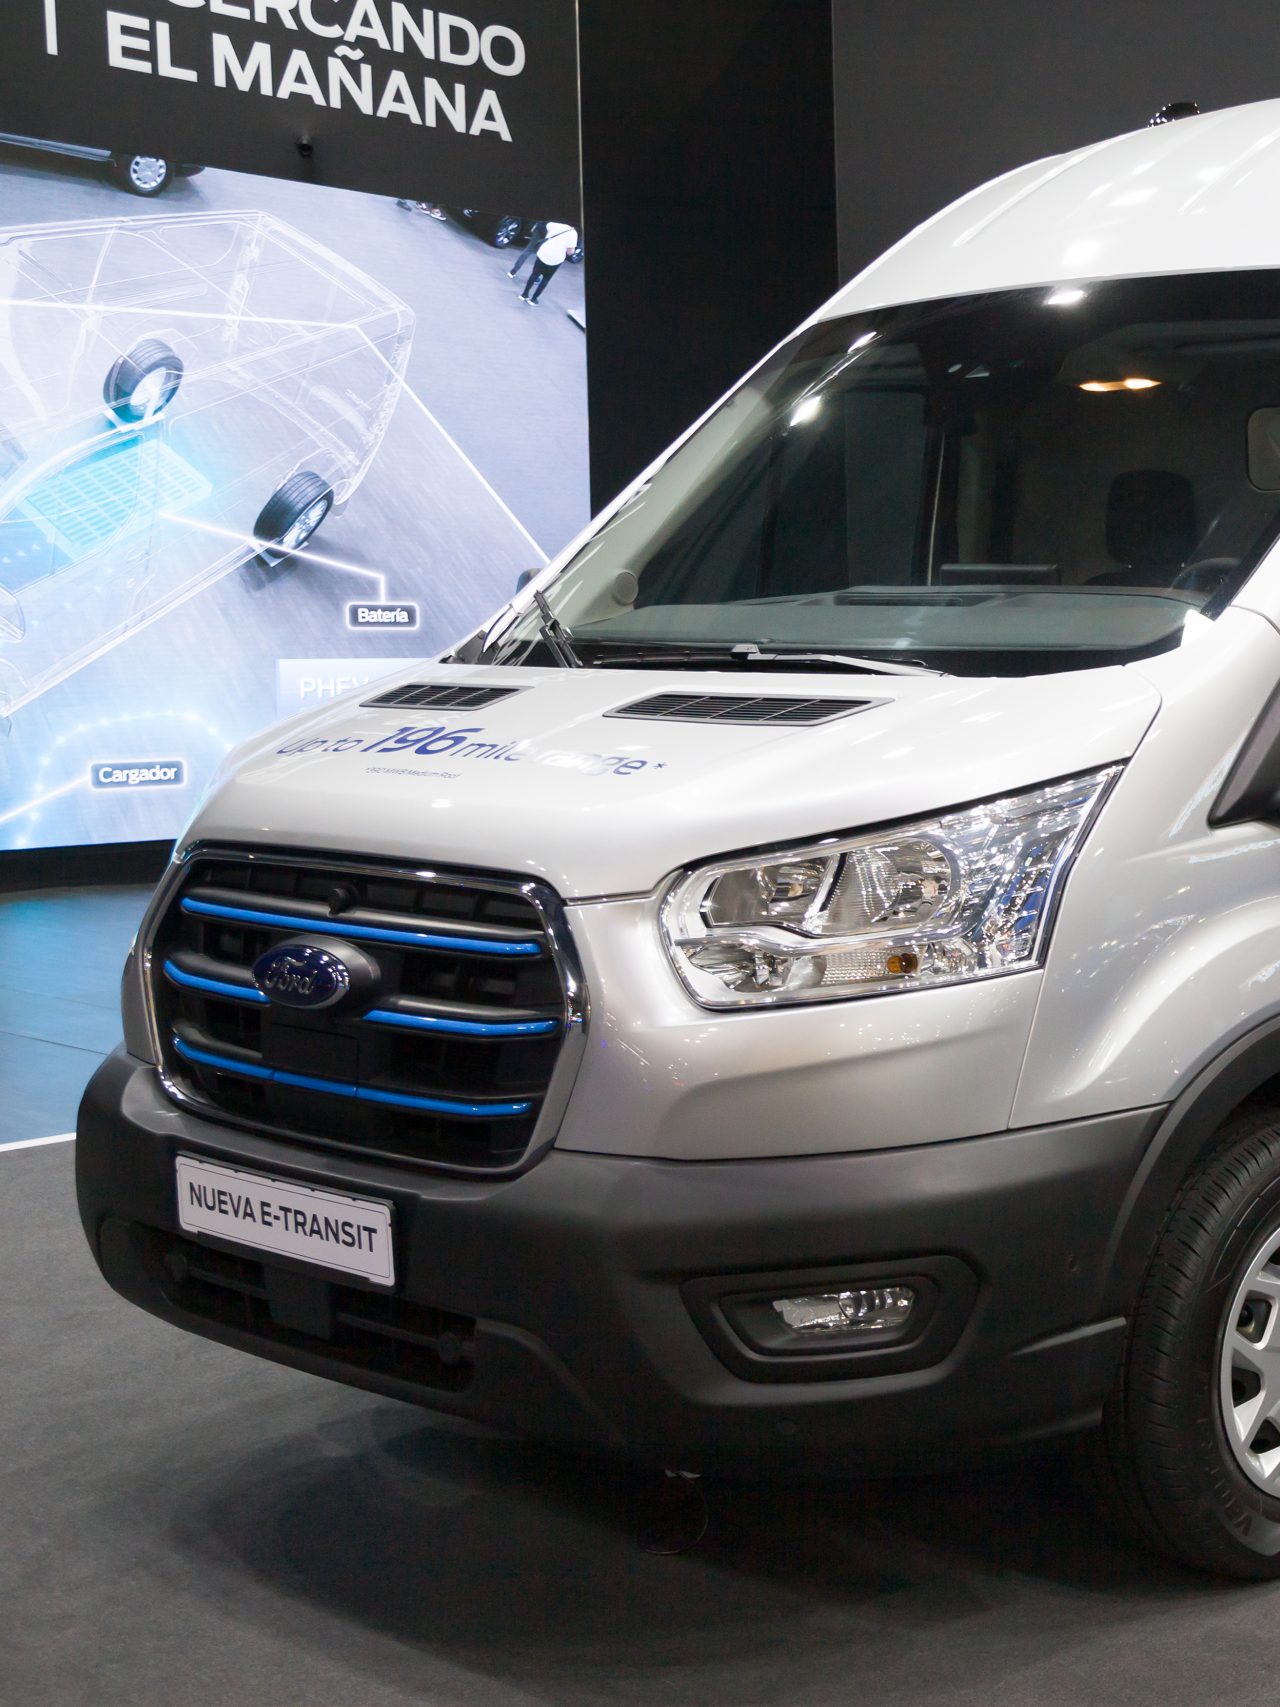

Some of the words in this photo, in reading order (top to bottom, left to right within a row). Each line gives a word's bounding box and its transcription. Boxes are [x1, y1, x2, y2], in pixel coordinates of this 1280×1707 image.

[168, 0, 525, 77] RCANDO
[107, 11, 198, 82] EL
[211, 33, 513, 142] MAÑANA
[357, 607, 410, 623] Batería
[276, 737, 329, 757] Up
[321, 737, 364, 752] to
[360, 726, 486, 755] 196
[450, 738, 529, 762] mile
[98, 764, 178, 785] Cargador
[189, 1181, 257, 1223] NUEVA
[260, 1200, 378, 1253] E-TRANSIT
